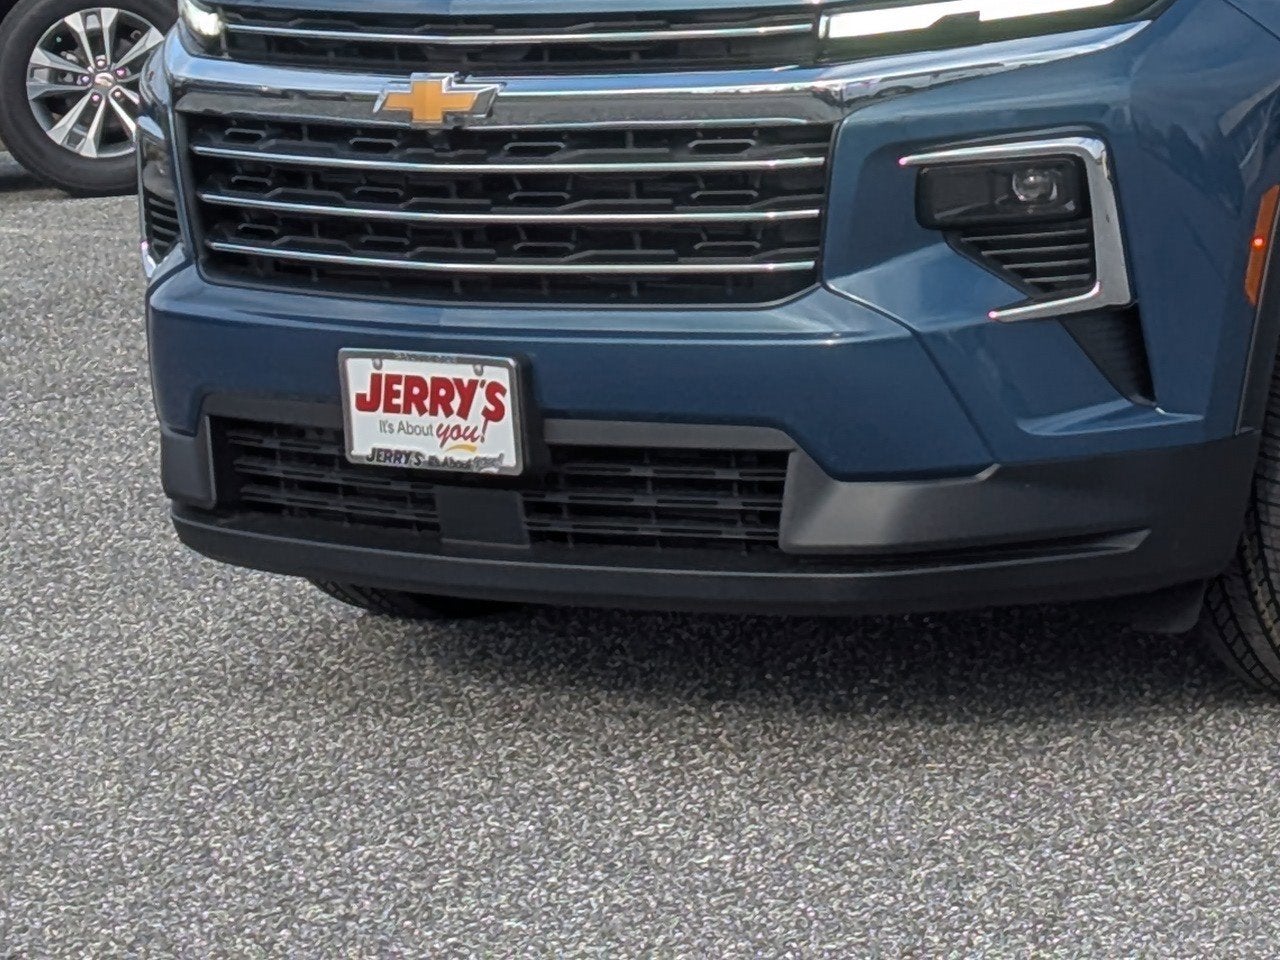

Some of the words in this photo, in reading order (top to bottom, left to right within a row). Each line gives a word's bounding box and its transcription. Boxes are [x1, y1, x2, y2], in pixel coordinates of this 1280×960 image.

[354, 372, 508, 423] JERRY'S
[378, 419, 395, 434] It's
[396, 420, 434, 437] About
[435, 418, 487, 449] you!
